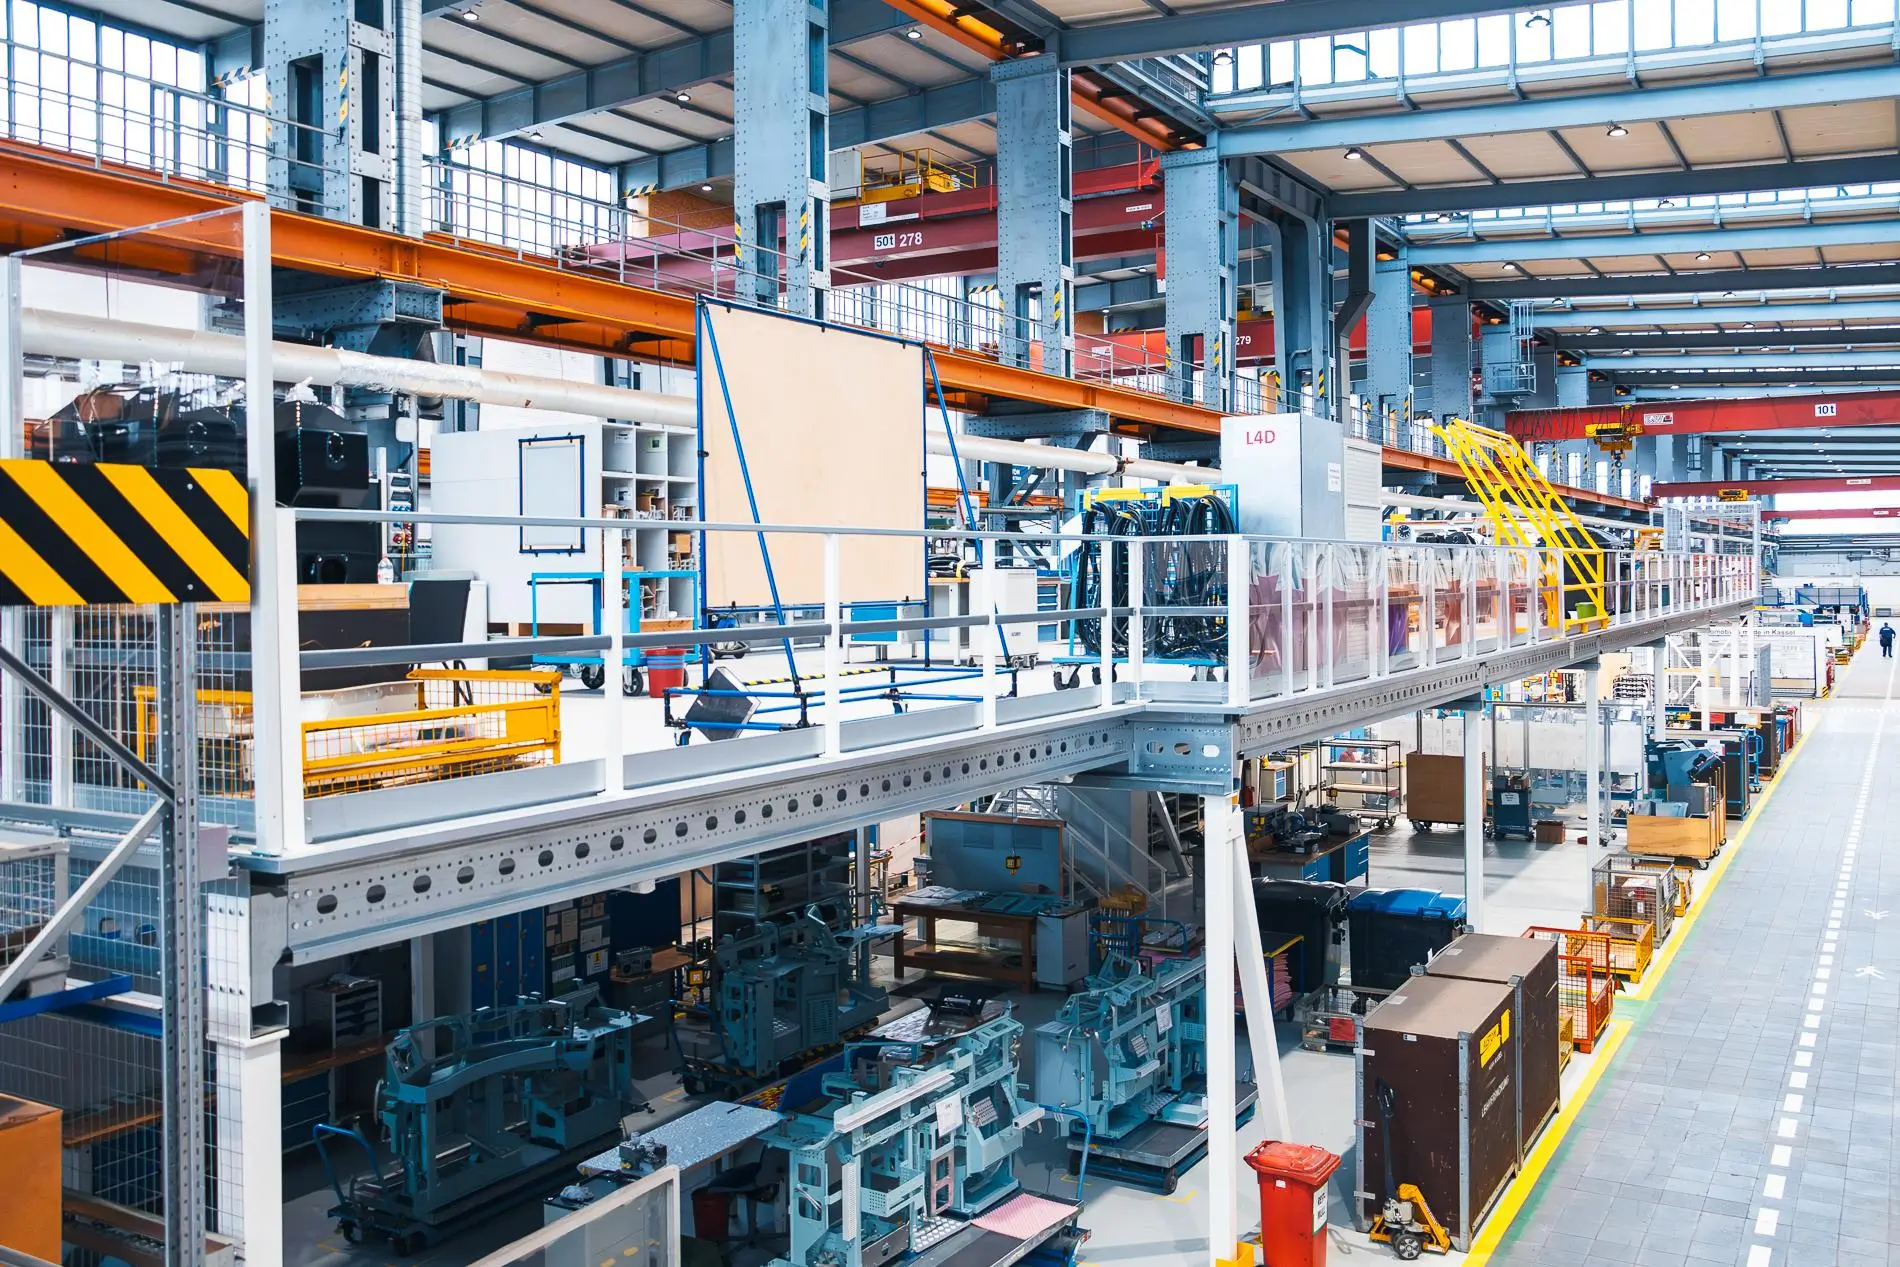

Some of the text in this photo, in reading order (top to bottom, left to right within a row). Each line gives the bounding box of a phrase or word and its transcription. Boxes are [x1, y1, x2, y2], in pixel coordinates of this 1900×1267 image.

[900, 232, 922, 247] 278
[1236, 336, 1251, 345] 279
[1246, 430, 1275, 445] L4D
